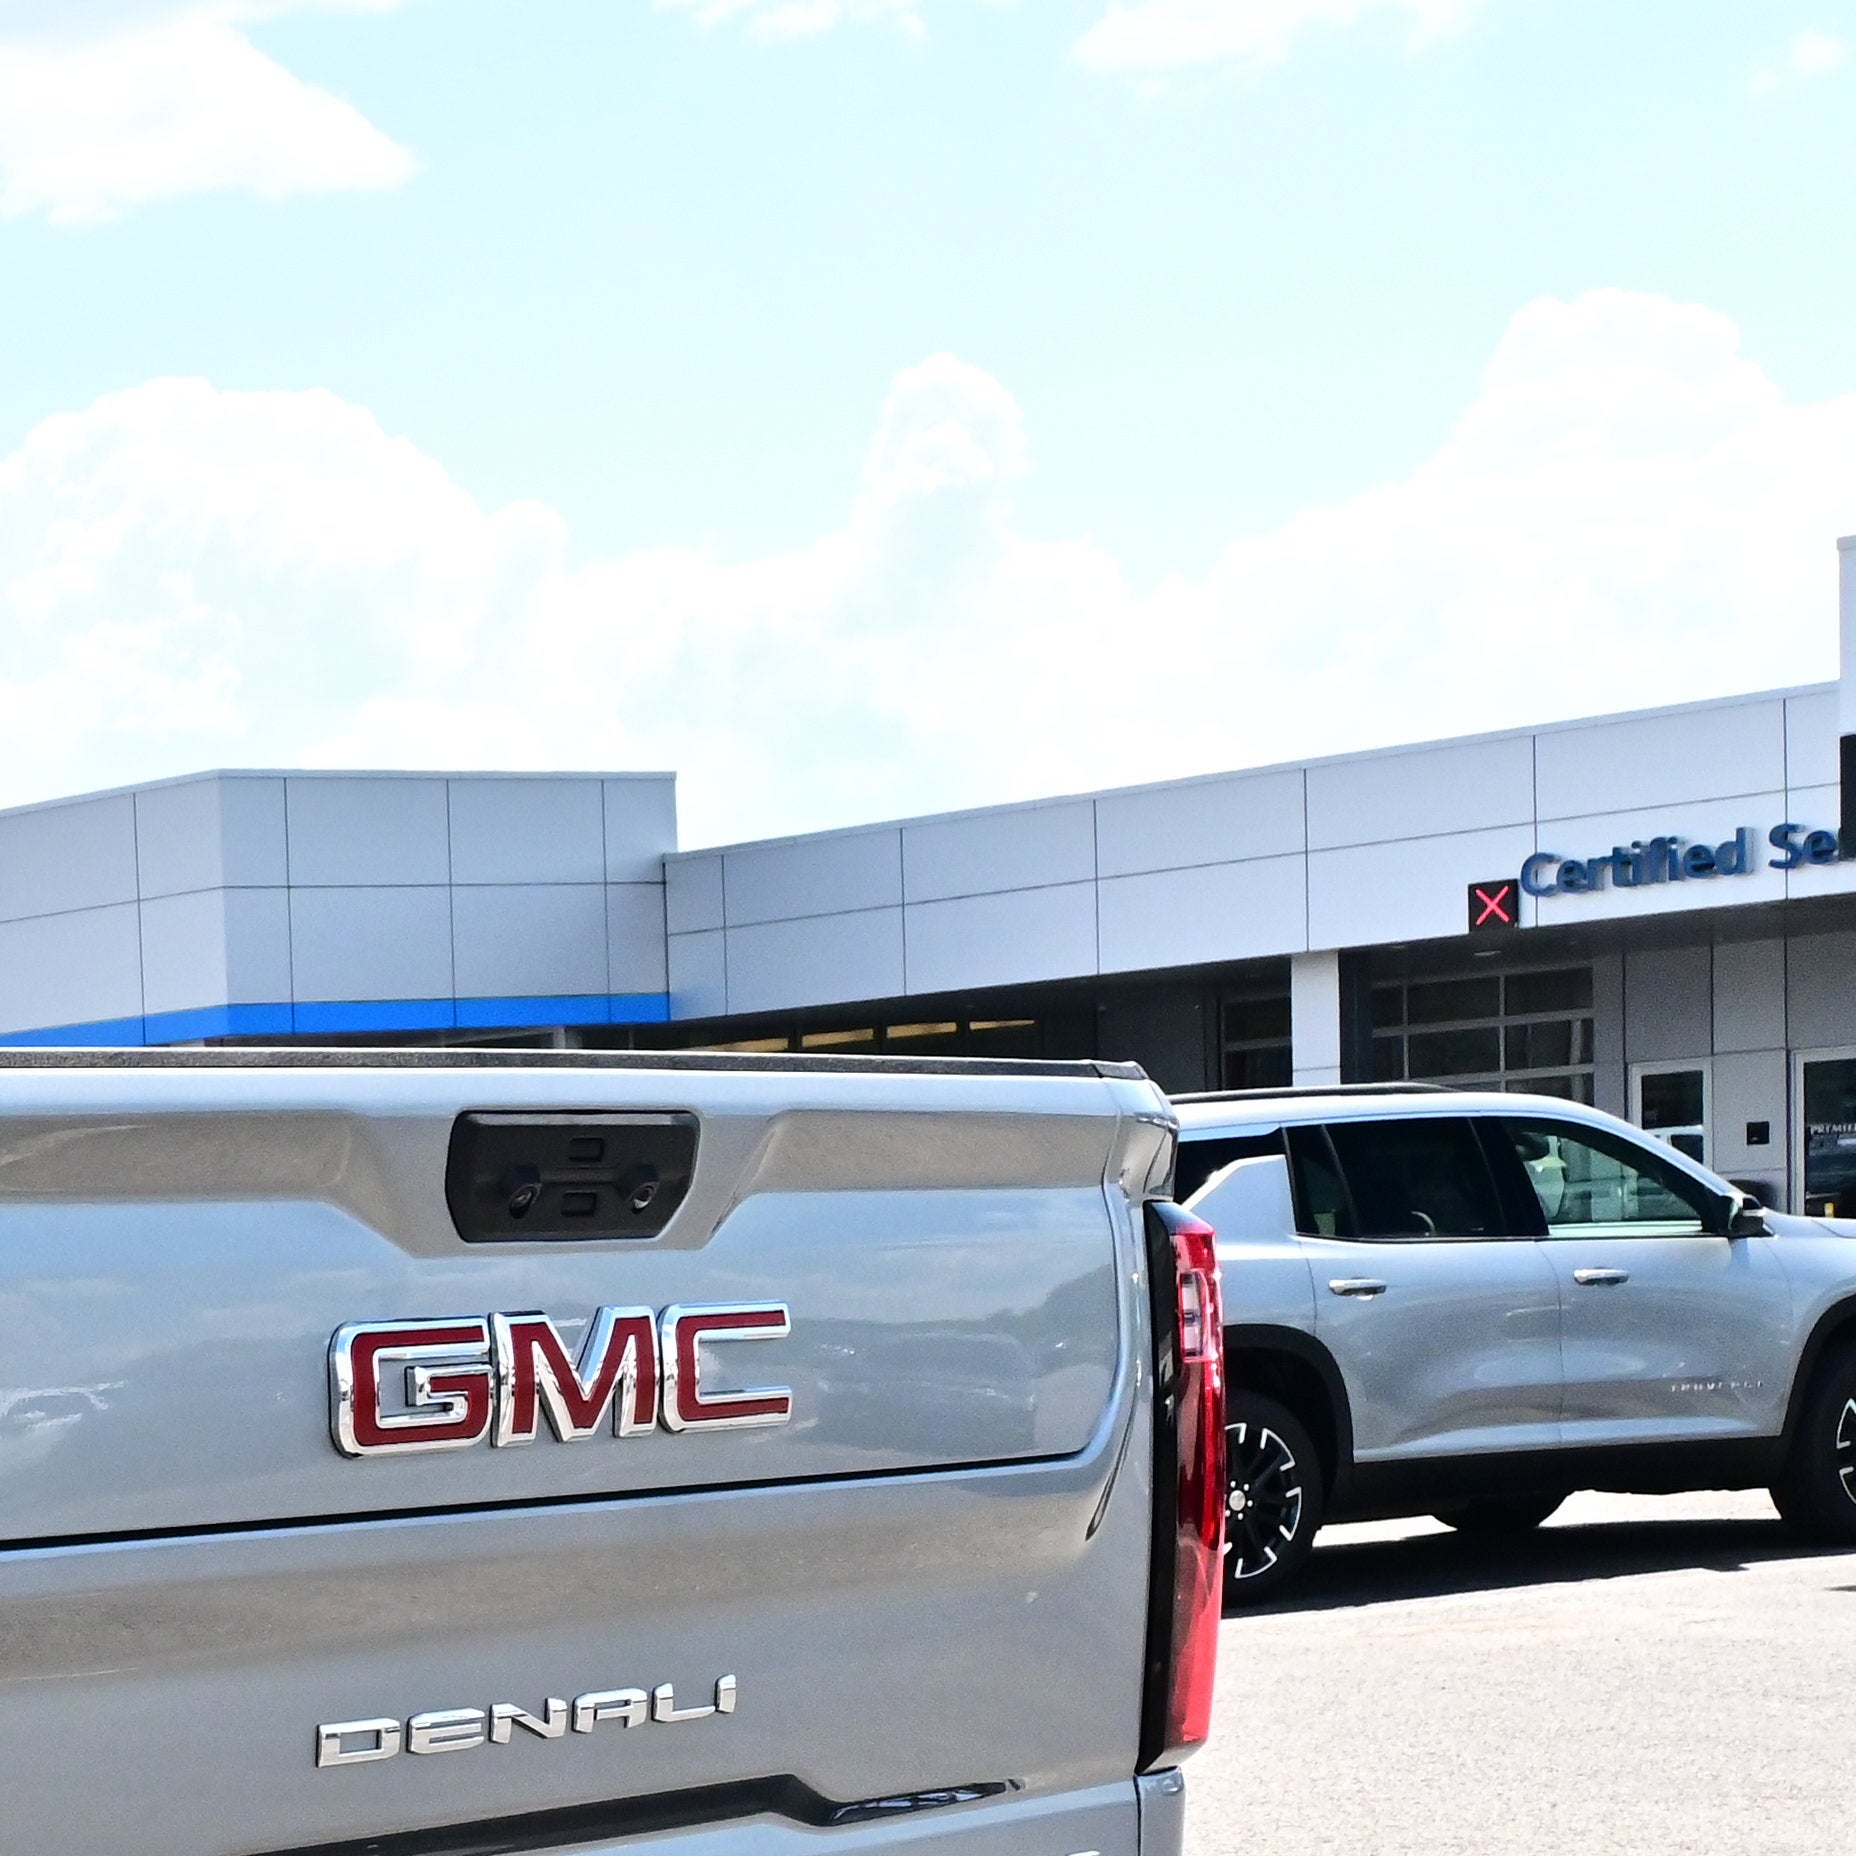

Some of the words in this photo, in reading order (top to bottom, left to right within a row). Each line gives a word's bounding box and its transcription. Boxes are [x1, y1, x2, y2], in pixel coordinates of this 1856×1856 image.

[1520, 825, 1752, 898] Certified
[328, 1301, 794, 1461] GMC
[315, 1674, 739, 1768] DENALI
